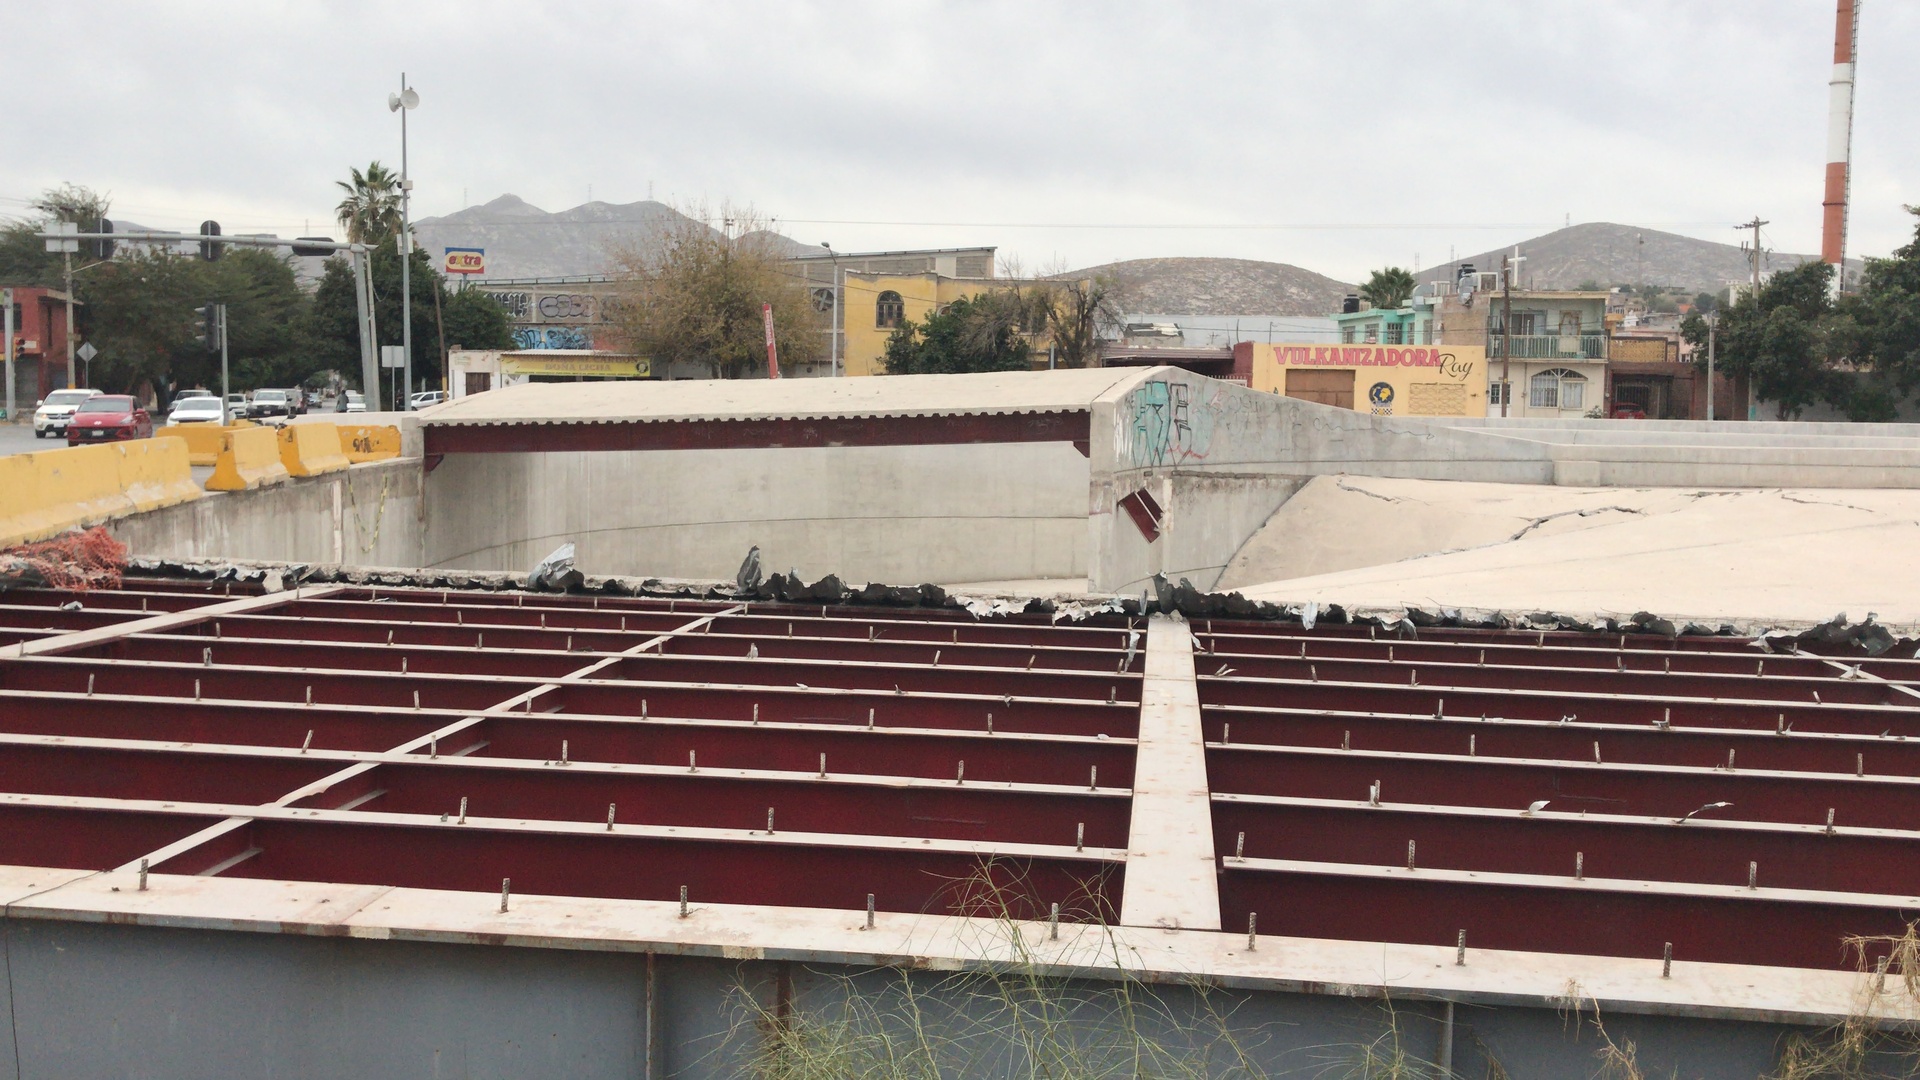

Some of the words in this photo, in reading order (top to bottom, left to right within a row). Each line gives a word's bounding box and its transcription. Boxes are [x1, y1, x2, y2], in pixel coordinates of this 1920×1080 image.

[449, 255, 482, 266] extra
[1273, 347, 1442, 367] VULKANIZADORA
[1435, 353, 1474, 382] Ray
